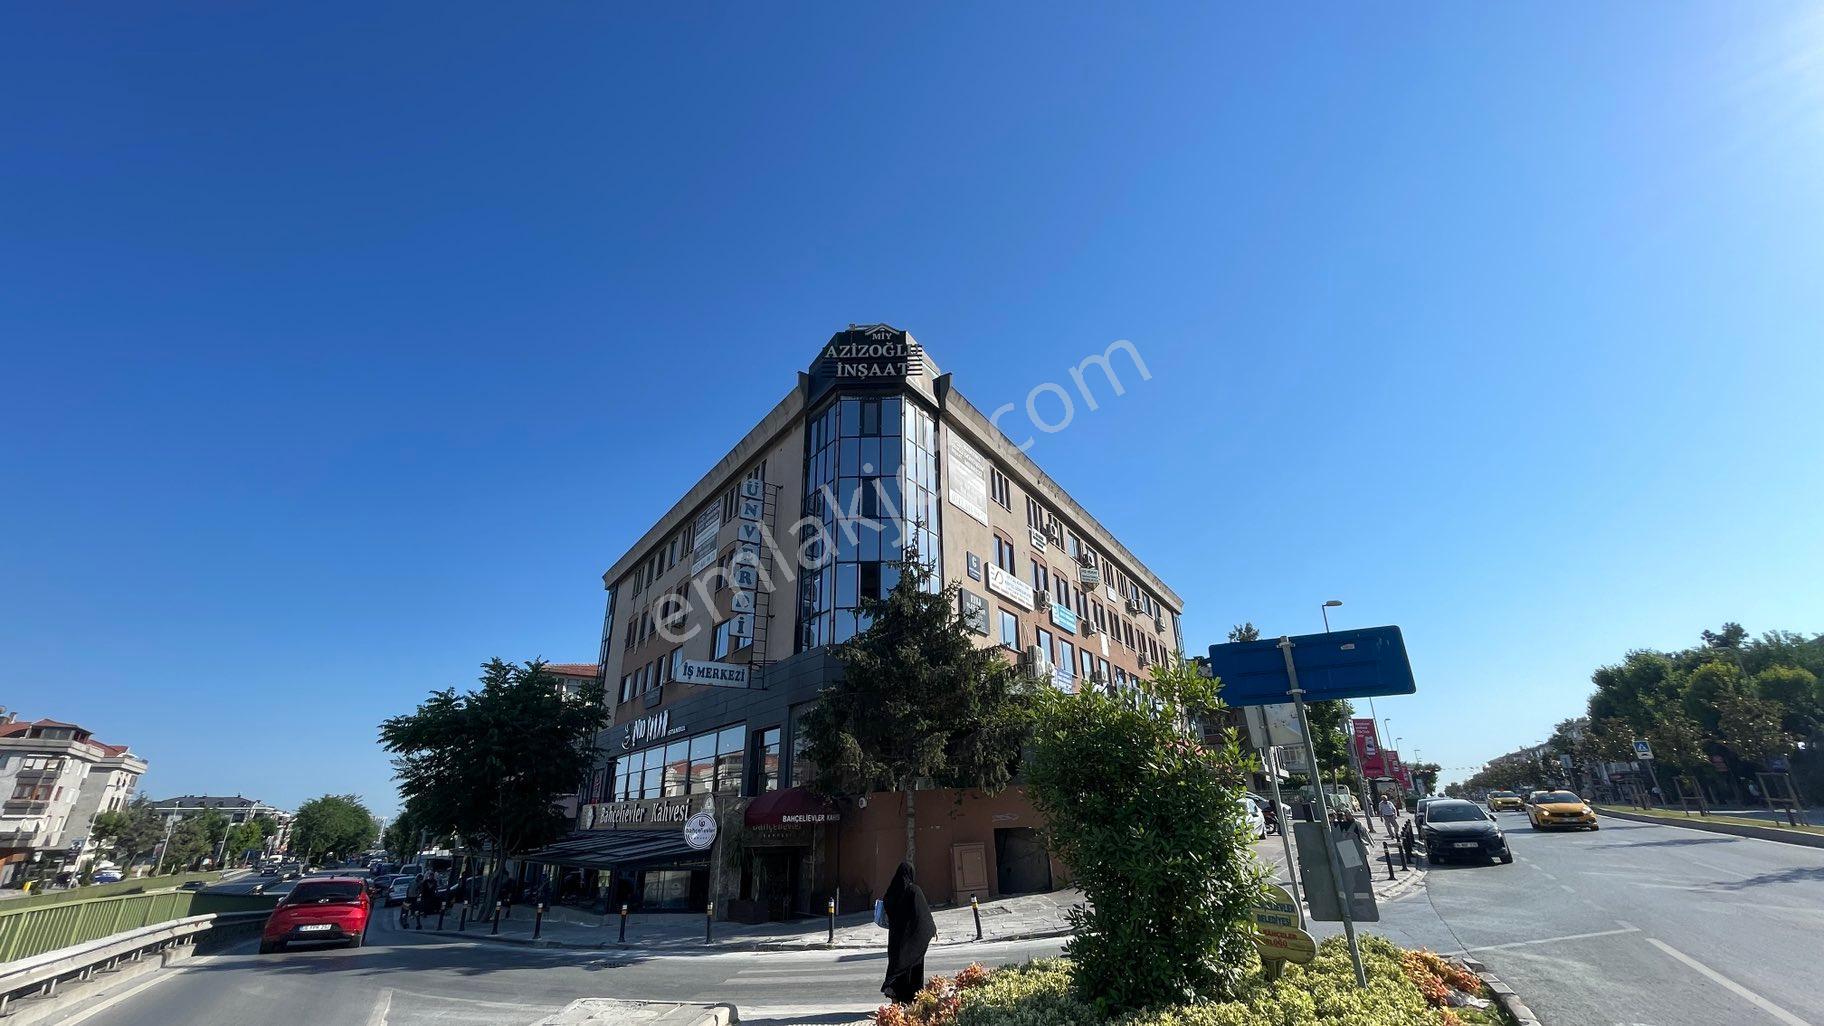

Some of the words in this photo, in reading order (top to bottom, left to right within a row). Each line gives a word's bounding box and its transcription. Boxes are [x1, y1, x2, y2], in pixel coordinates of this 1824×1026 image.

[836, 362, 910, 379] İNŞAAT
[682, 662, 694, 679] İŞ
[696, 666, 746, 682] MERKEZİ
[600, 804, 645, 828] Bahçelievler
[650, 798, 690, 822] Kahvesi
